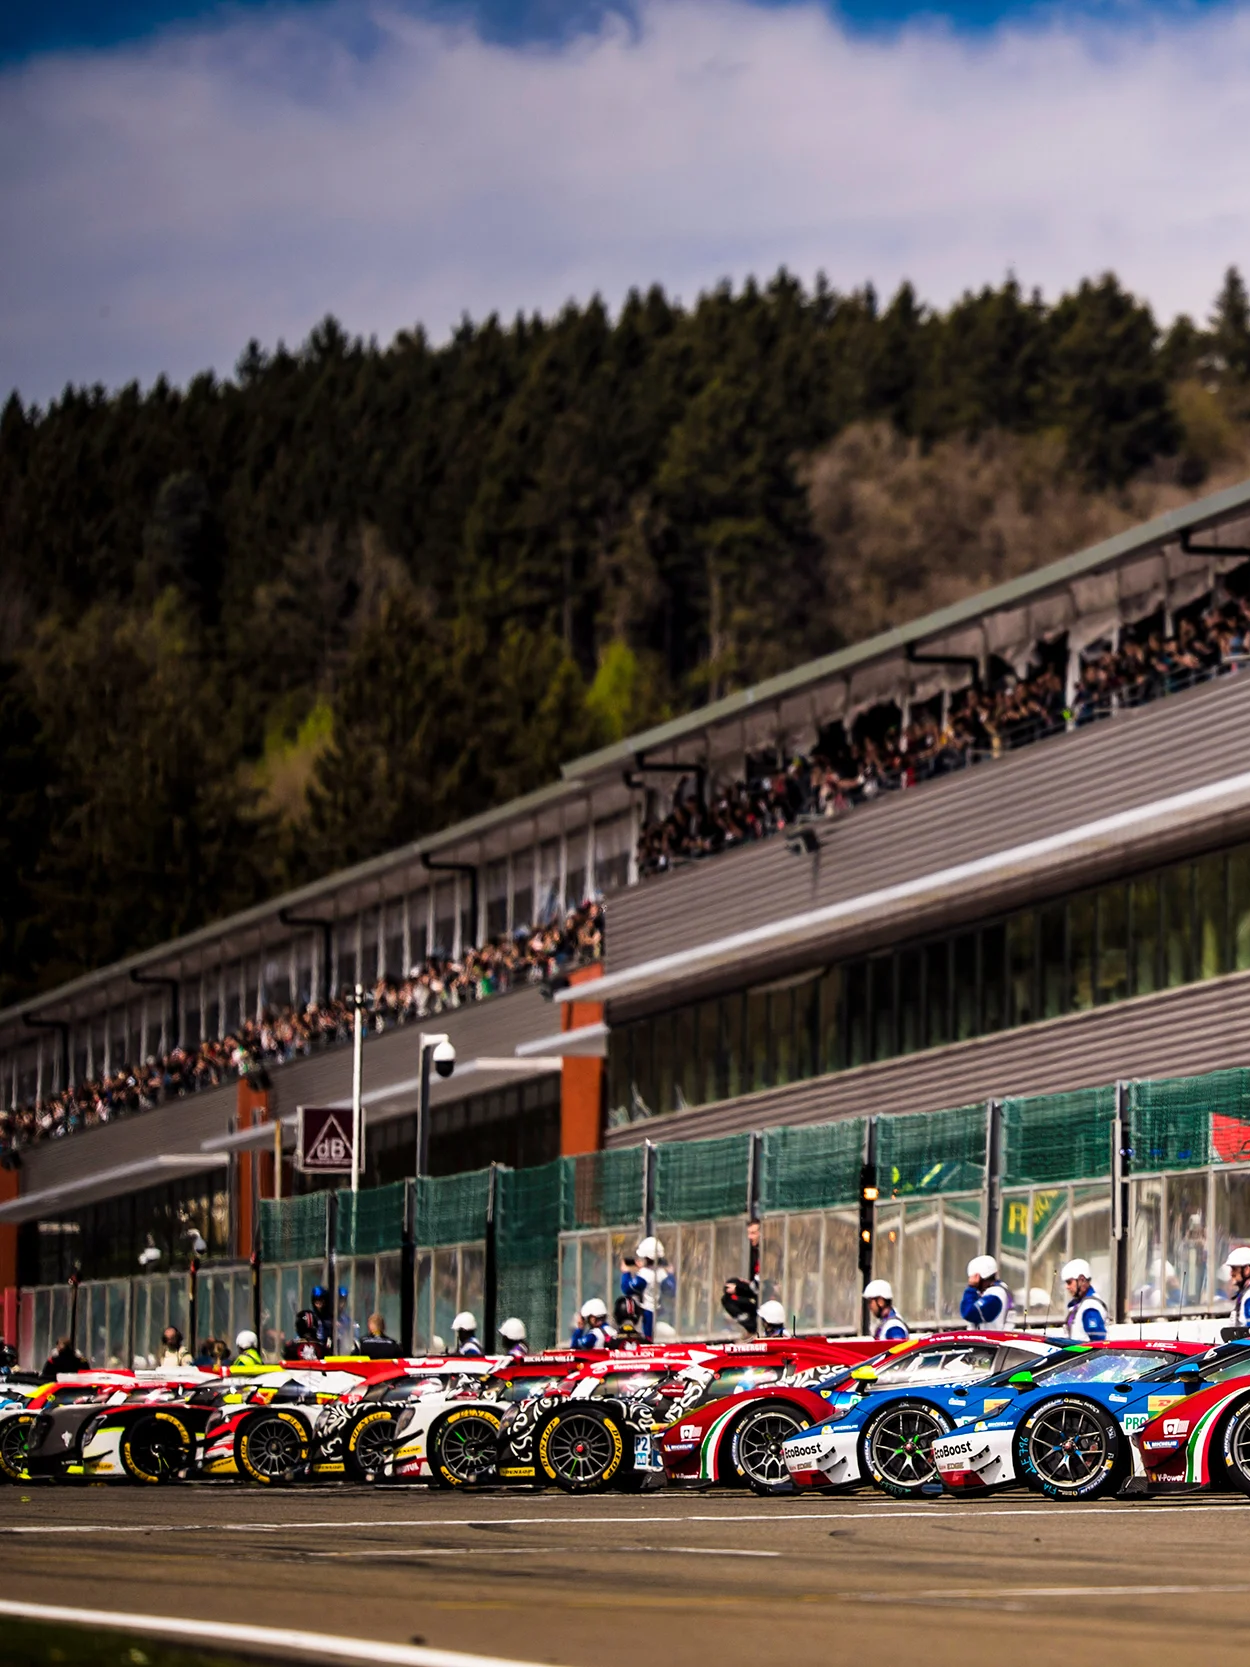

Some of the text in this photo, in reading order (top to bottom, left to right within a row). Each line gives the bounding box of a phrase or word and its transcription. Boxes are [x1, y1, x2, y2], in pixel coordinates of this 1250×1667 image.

[317, 1138, 345, 1160] dB
[609, 1350, 655, 1358] REBELLION
[540, 1420, 556, 1469] DUNLOP
[636, 1437, 648, 1451] P2
[1224, 1417, 1236, 1454] MICHELIN
[607, 1429, 622, 1478] DUNLOP
[785, 1442, 822, 1459] EcoBoost
[934, 1441, 972, 1459] EcoBoost
[1078, 1471, 1107, 1495] MICHELIN
[1157, 1472, 1185, 1482] V-Power
